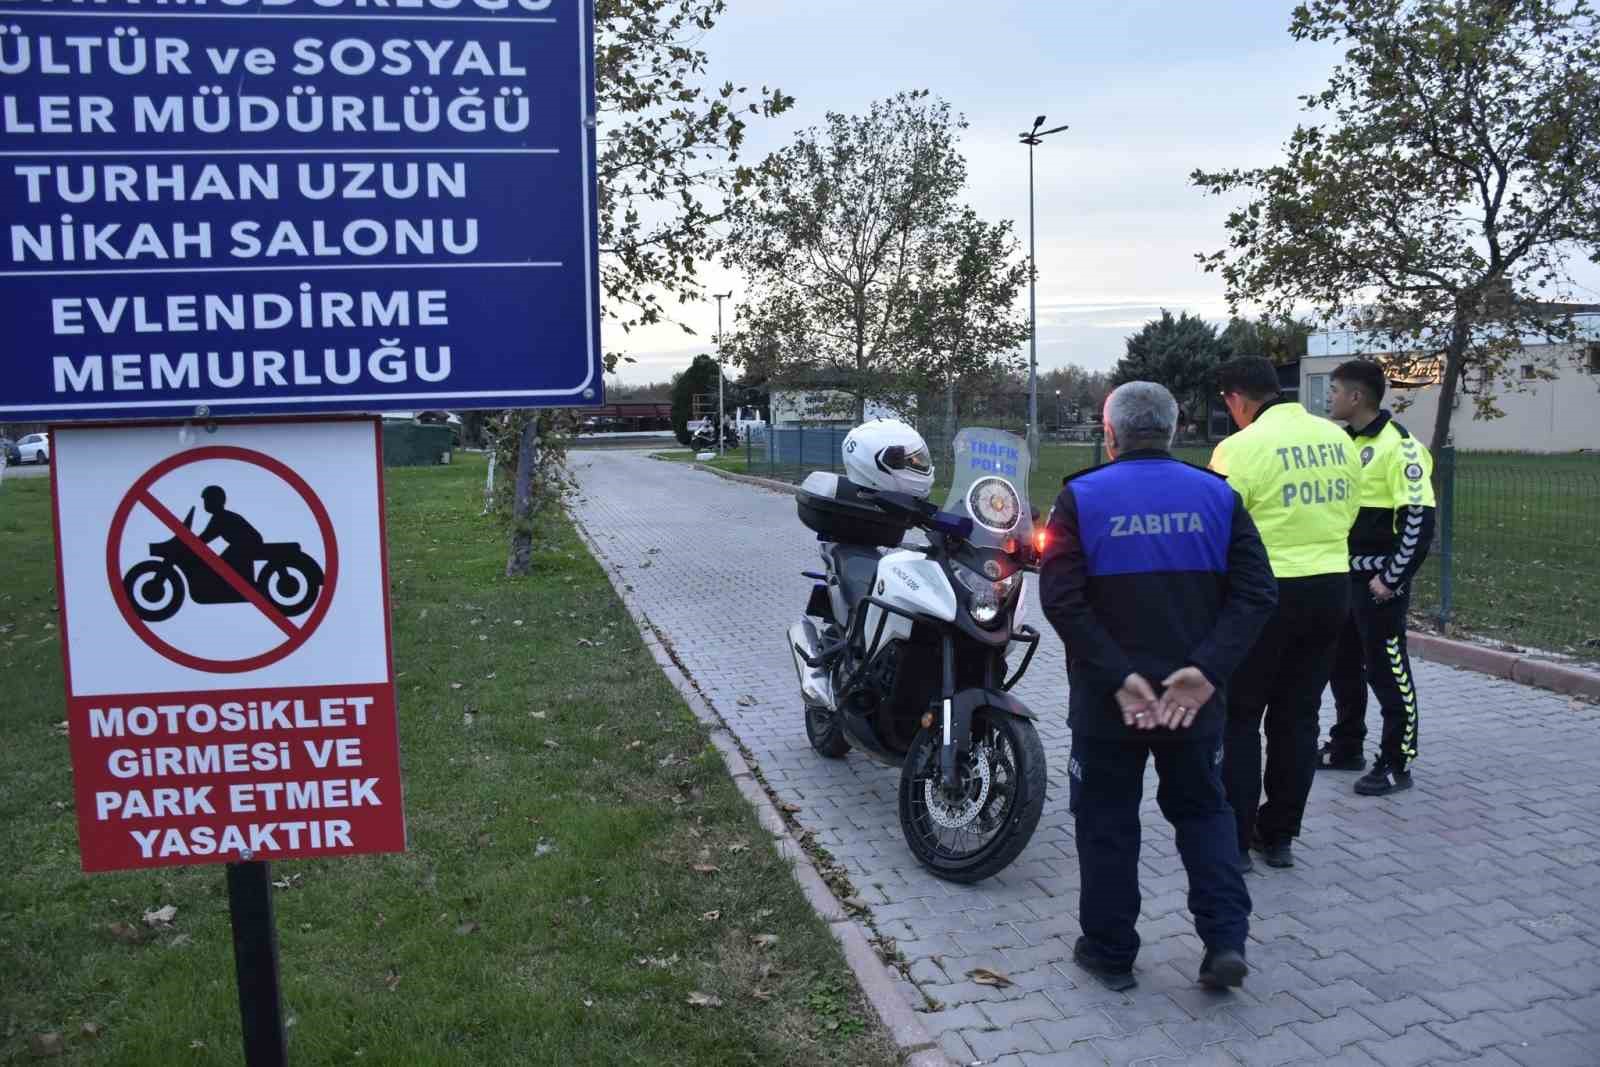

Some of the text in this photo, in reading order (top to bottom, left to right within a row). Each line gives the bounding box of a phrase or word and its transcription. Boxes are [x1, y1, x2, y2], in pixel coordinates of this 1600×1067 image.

[205, 47, 276, 76] ve
[293, 37, 527, 77] SOSYAL
[4, 86, 530, 133] LER MÜDÜRLÜĞÜ
[14, 162, 466, 203] TURHAN UZUN
[10, 213, 479, 262] NİKAH SALONU
[51, 281, 449, 335] EVLENDİRME
[52, 338, 452, 393] MEMURLUĞU
[1109, 512, 1204, 537] ZABITA
[304, 738, 363, 768] VE
[95, 778, 382, 820] PARK ETMEK
[130, 819, 354, 858] YASAKTIR
